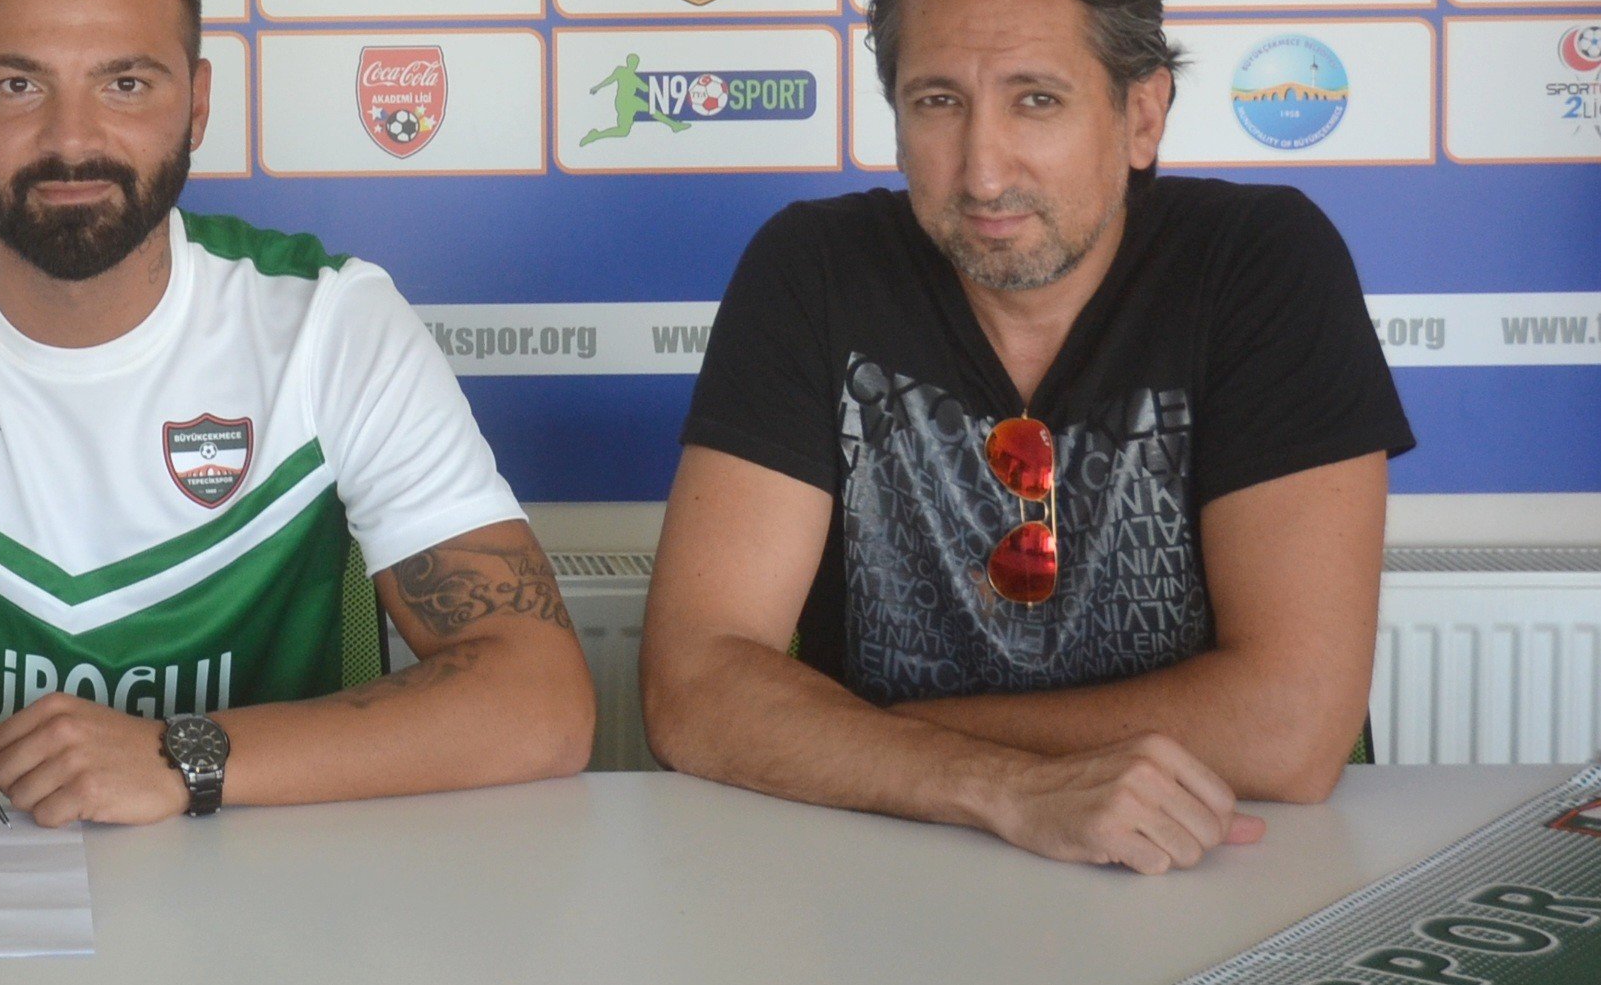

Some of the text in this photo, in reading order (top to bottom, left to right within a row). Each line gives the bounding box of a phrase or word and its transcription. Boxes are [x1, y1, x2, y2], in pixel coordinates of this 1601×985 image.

[729, 79, 809, 110] SPORT
[1546, 83, 1601, 95] SPORT
[652, 325, 714, 354] ww
[1501, 313, 1601, 345] www.
[1305, 882, 1601, 985] POR
